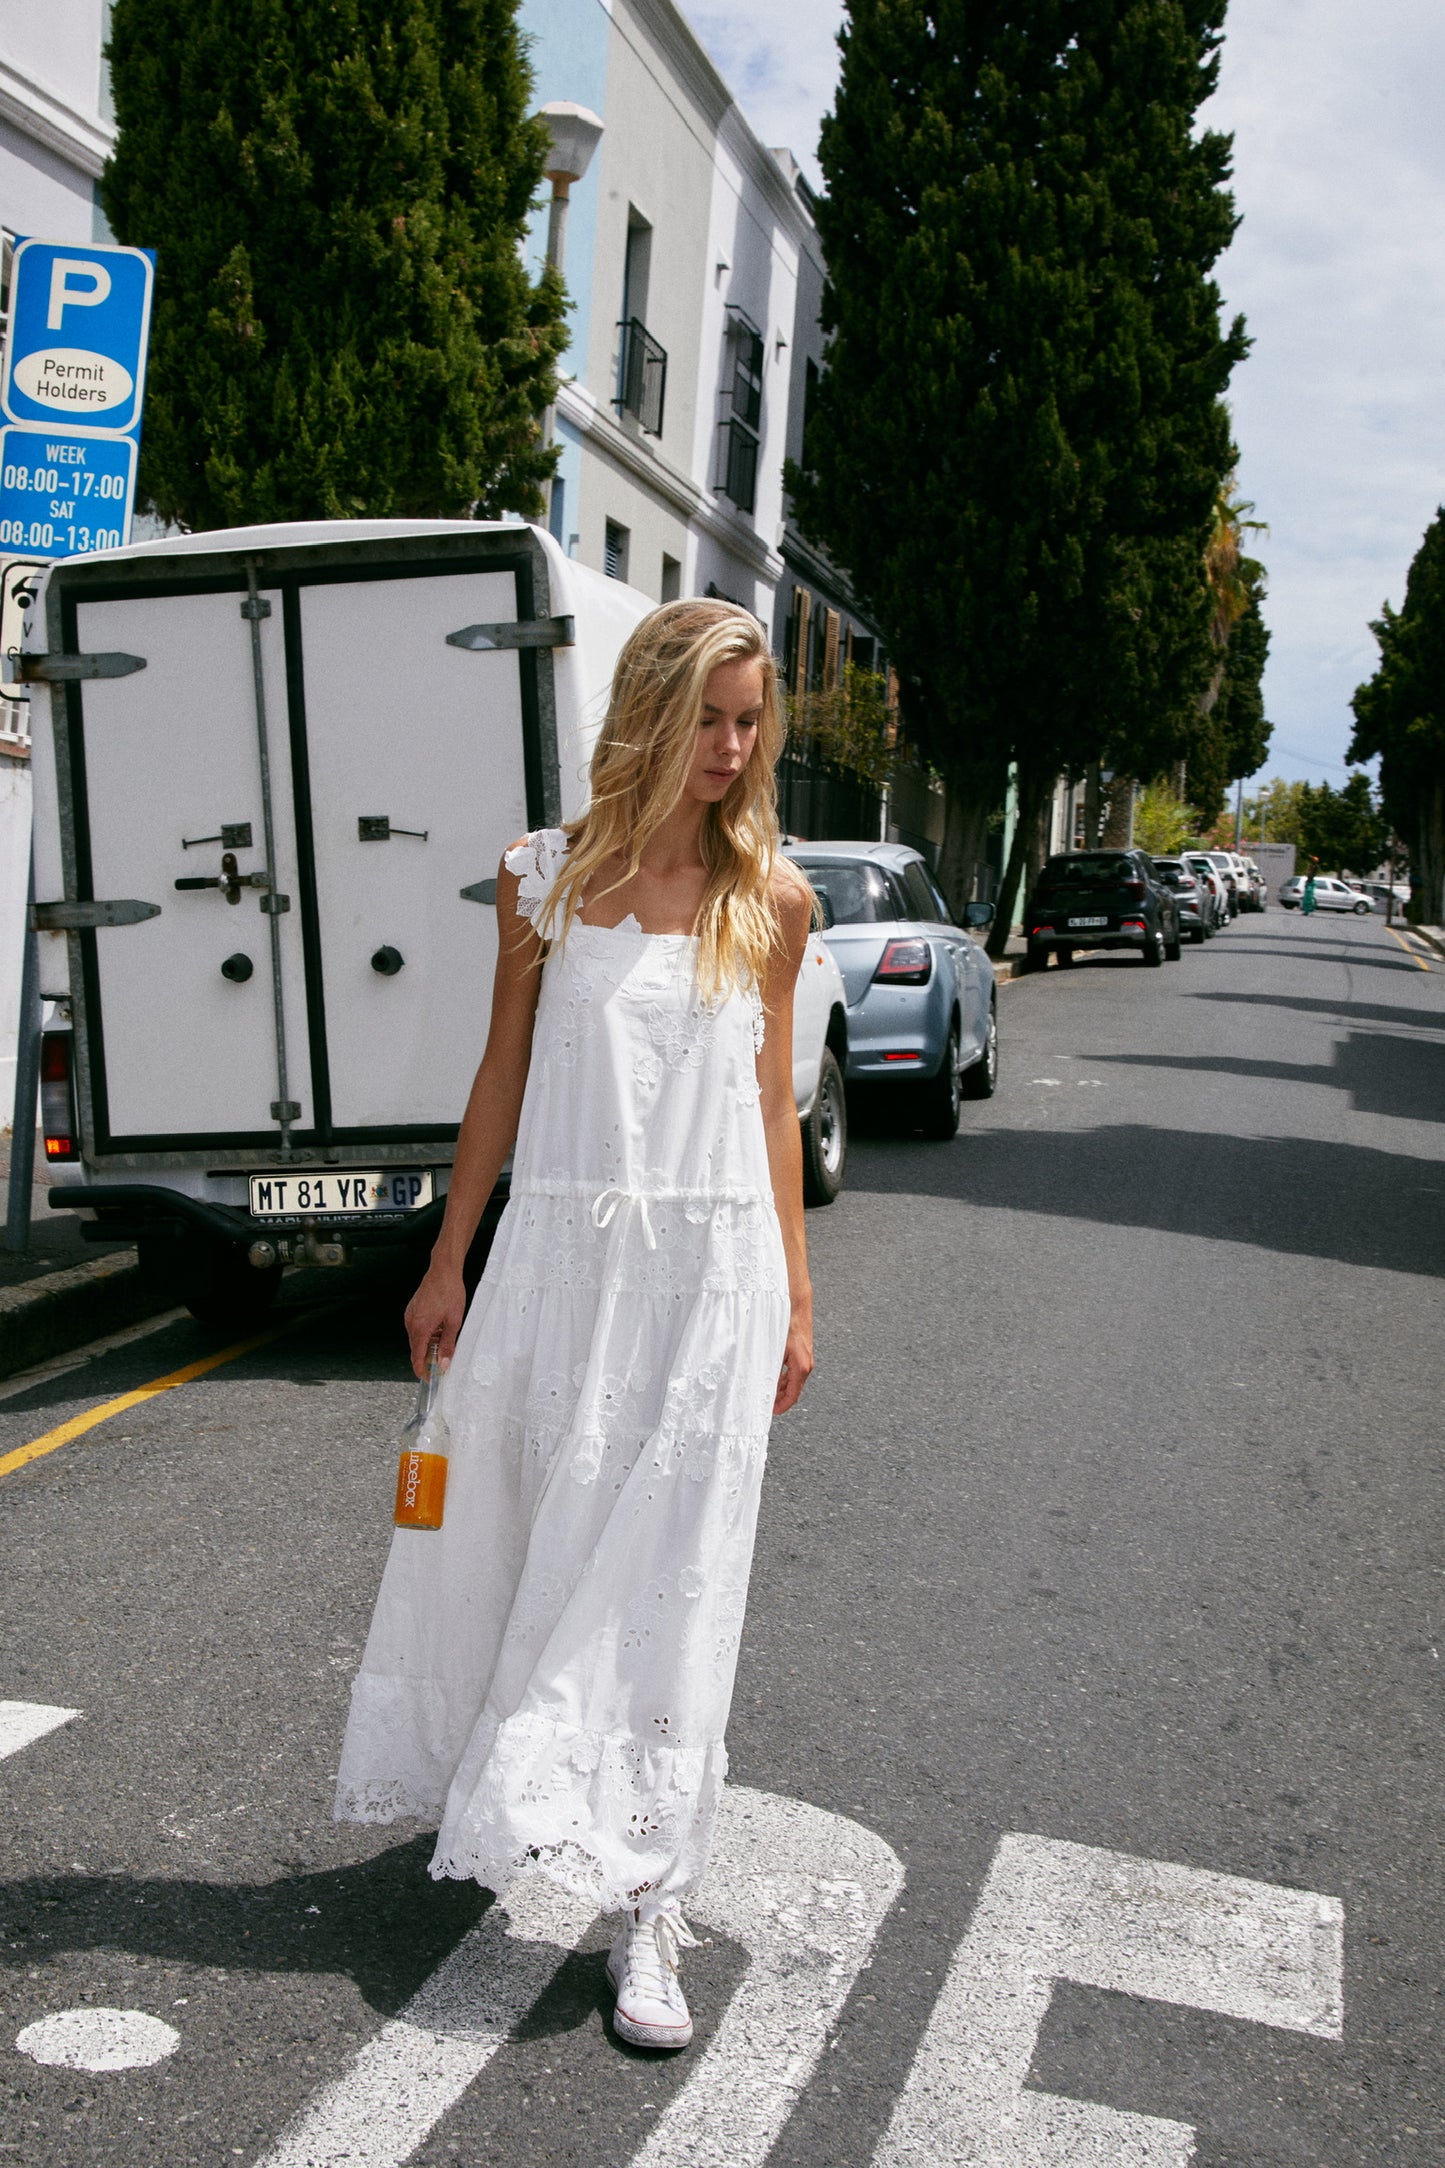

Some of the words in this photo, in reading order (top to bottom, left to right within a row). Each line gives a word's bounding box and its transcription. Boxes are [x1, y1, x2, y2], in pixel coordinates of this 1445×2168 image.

[47, 257, 112, 330] P
[43, 359, 105, 382] Permit
[36, 380, 107, 403] Holders
[46, 443, 86, 465] WEEK
[49, 500, 76, 519] SAT
[258, 1181, 287, 1211] MT
[298, 1180, 327, 1209] 81
[337, 1178, 368, 1208] YR
[392, 1176, 422, 1206] GP
